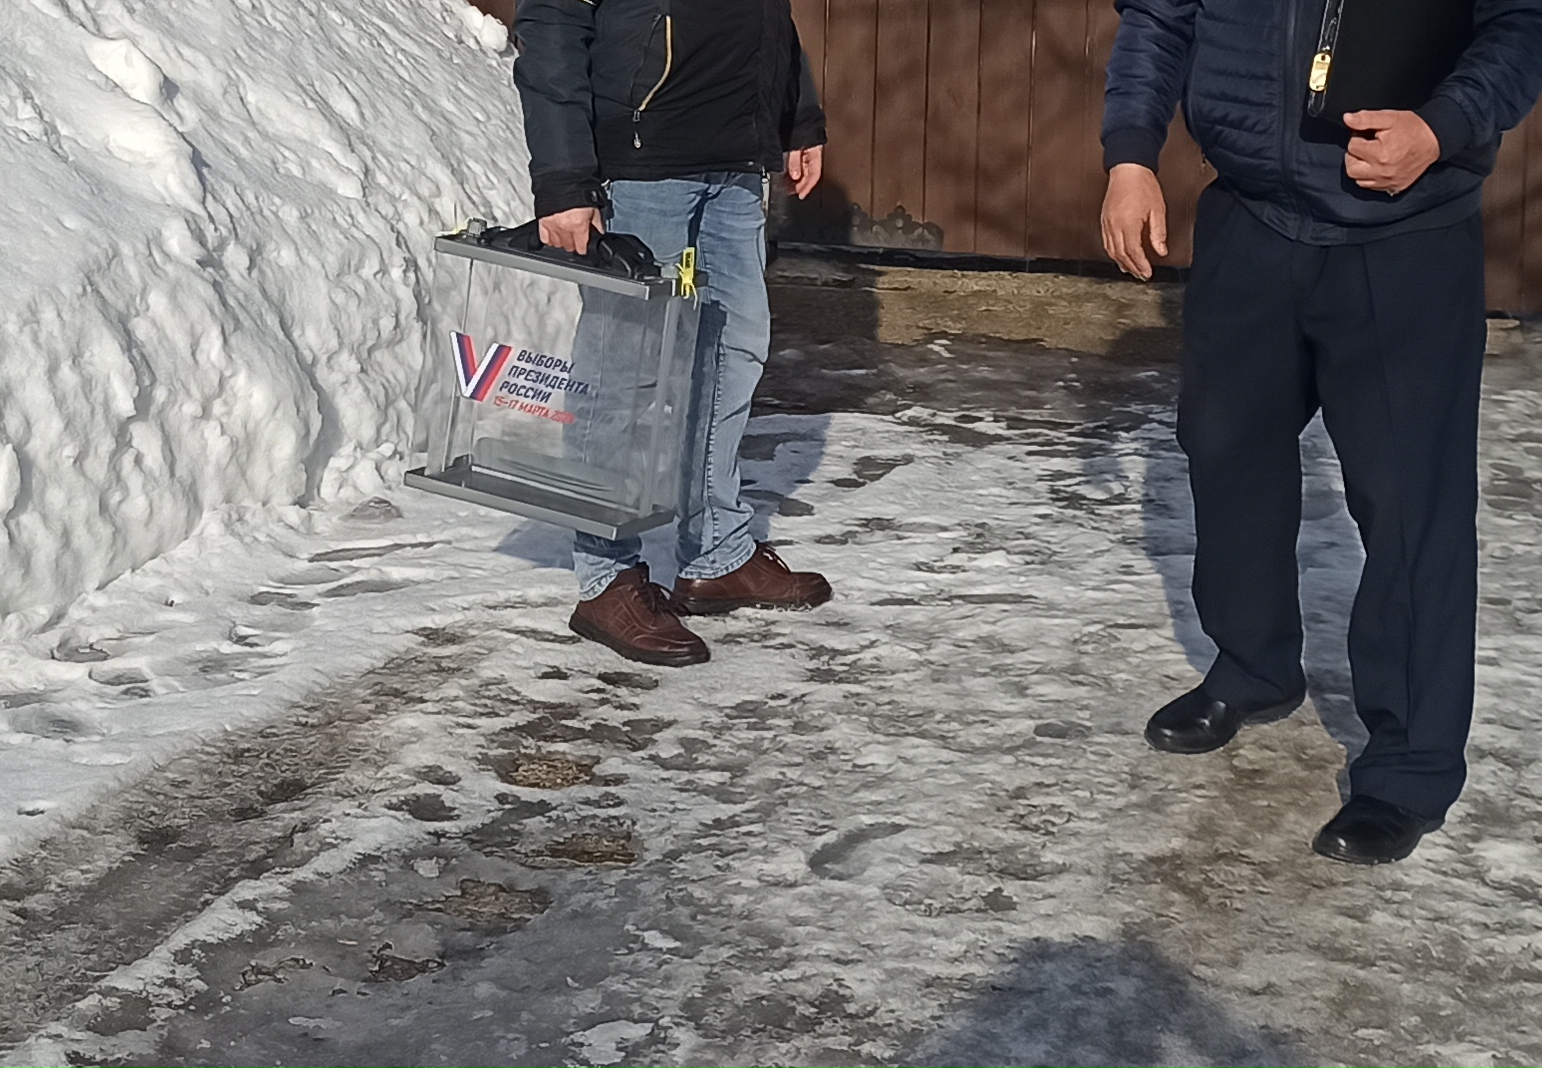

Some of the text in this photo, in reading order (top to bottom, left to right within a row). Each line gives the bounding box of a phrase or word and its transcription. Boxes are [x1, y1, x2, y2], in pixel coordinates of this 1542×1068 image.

[517, 350, 574, 373] ВЫБОРЫ
[508, 365, 590, 395] ПРЕЗИДЕНТА
[499, 381, 552, 403] РОССИИ
